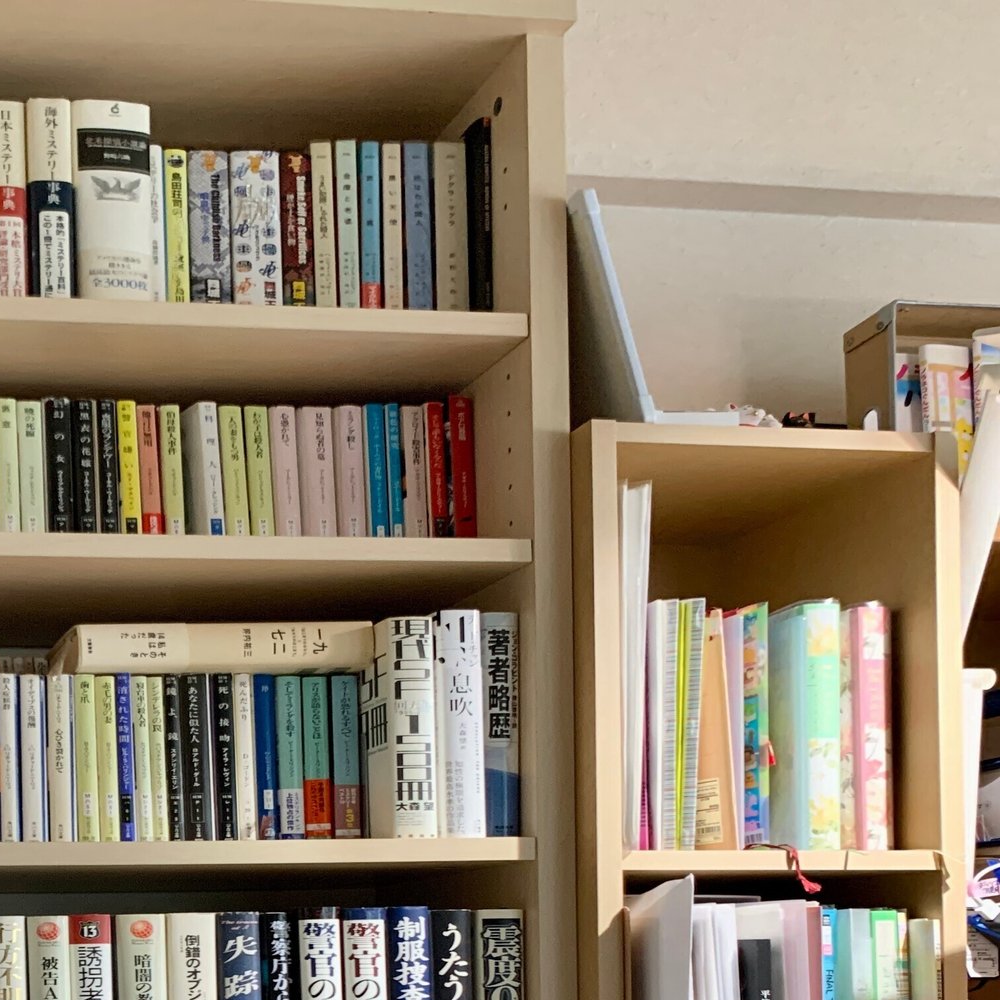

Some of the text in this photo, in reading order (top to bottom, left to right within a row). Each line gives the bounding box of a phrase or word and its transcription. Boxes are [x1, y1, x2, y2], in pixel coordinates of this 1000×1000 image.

[0, 110, 15, 211] 日本ミステリー事典
[45, 106, 61, 205] 海外ミステリー事典
[210, 174, 221, 262] The Childish Darkness
[92, 278, 148, 292] 全3000枚
[53, 411, 64, 463] 幻の女
[80, 412, 92, 468] 黒衣の花嫁
[166, 412, 176, 455] 伯母殺人事件
[240, 682, 248, 721] 死んだふり
[450, 673, 473, 717] 息吹
[488, 629, 511, 739] 著者略歴
[118, 686, 130, 743] 消された時間
[188, 687, 200, 743] あなたに似た人
[218, 687, 230, 743] 死の接吻
[396, 802, 434, 811] 大森望
[83, 925, 97, 937] 13
[40, 957, 59, 1000] 被告A
[825, 969, 834, 993] FINAL
